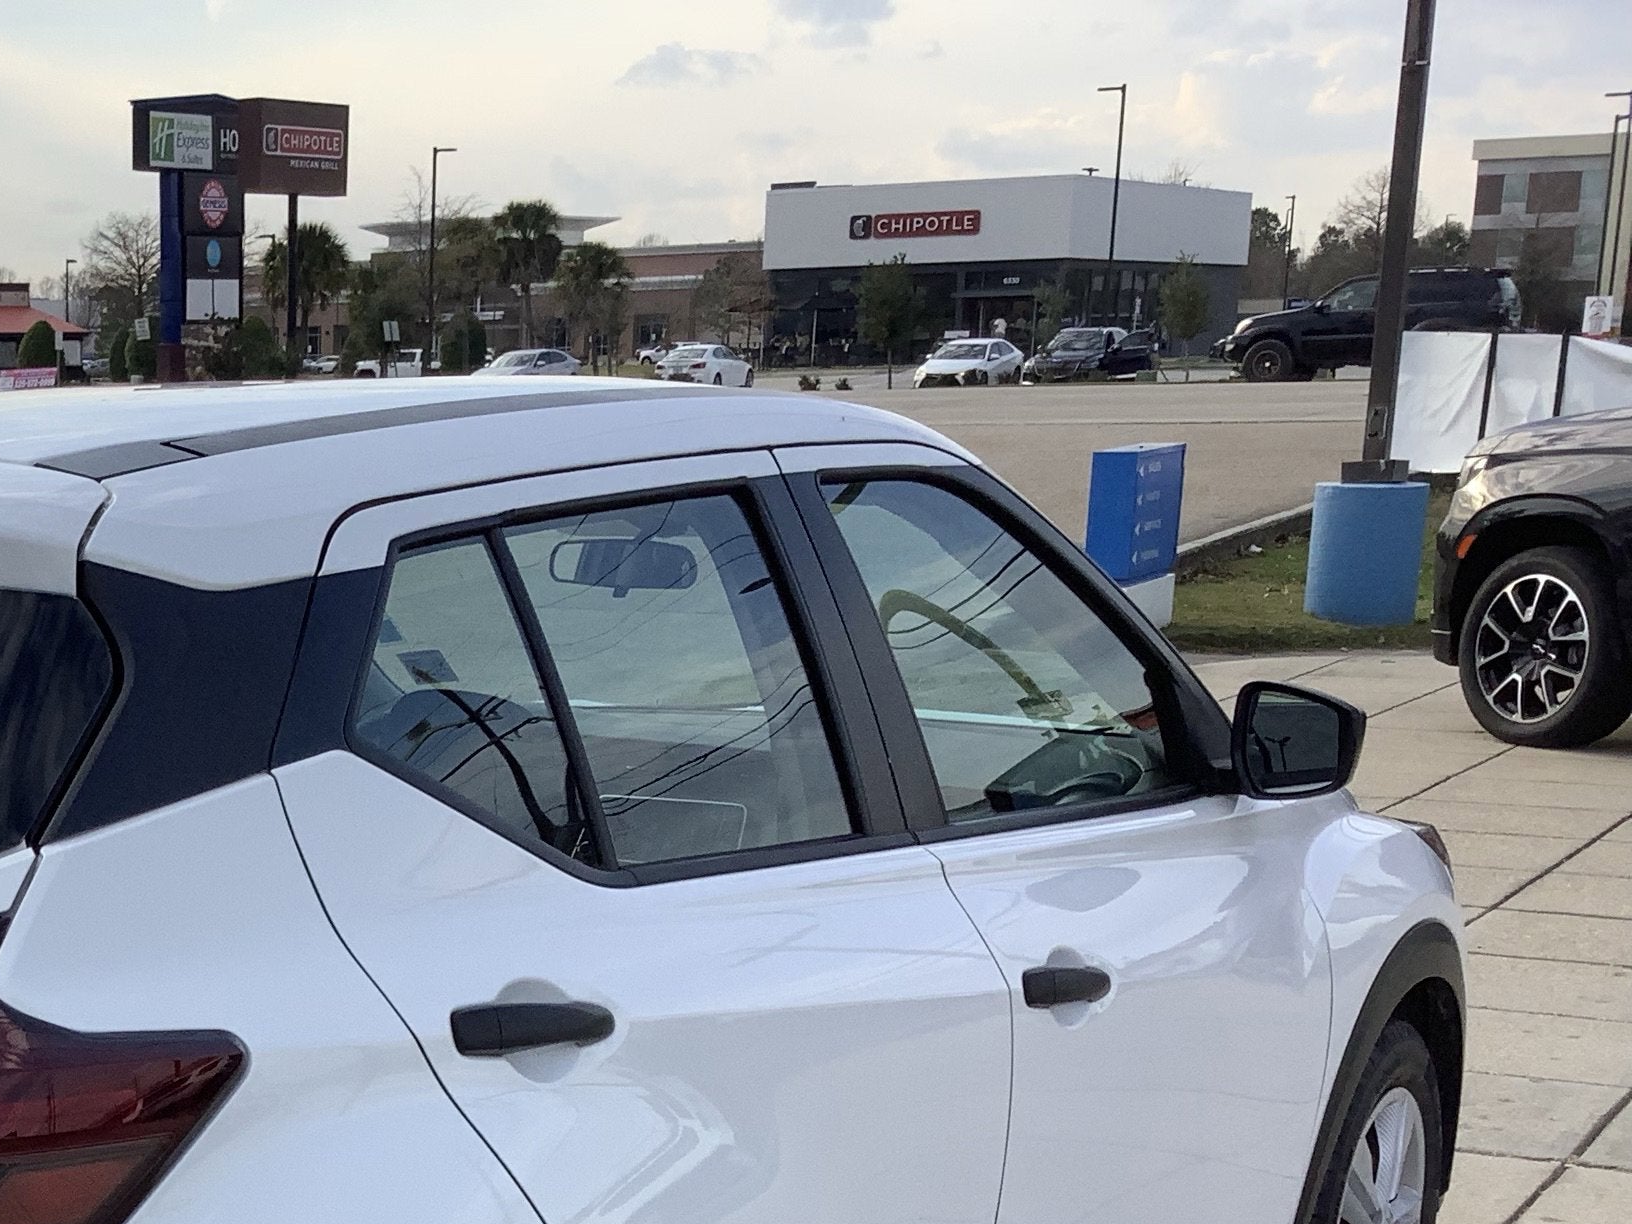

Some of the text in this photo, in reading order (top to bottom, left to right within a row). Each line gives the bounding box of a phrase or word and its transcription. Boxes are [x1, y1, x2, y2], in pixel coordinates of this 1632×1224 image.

[176, 131, 210, 151] Express
[282, 132, 340, 151] CHIPOTLE
[289, 159, 319, 169] MEXICAN
[877, 214, 976, 234] CHIPOTLE
